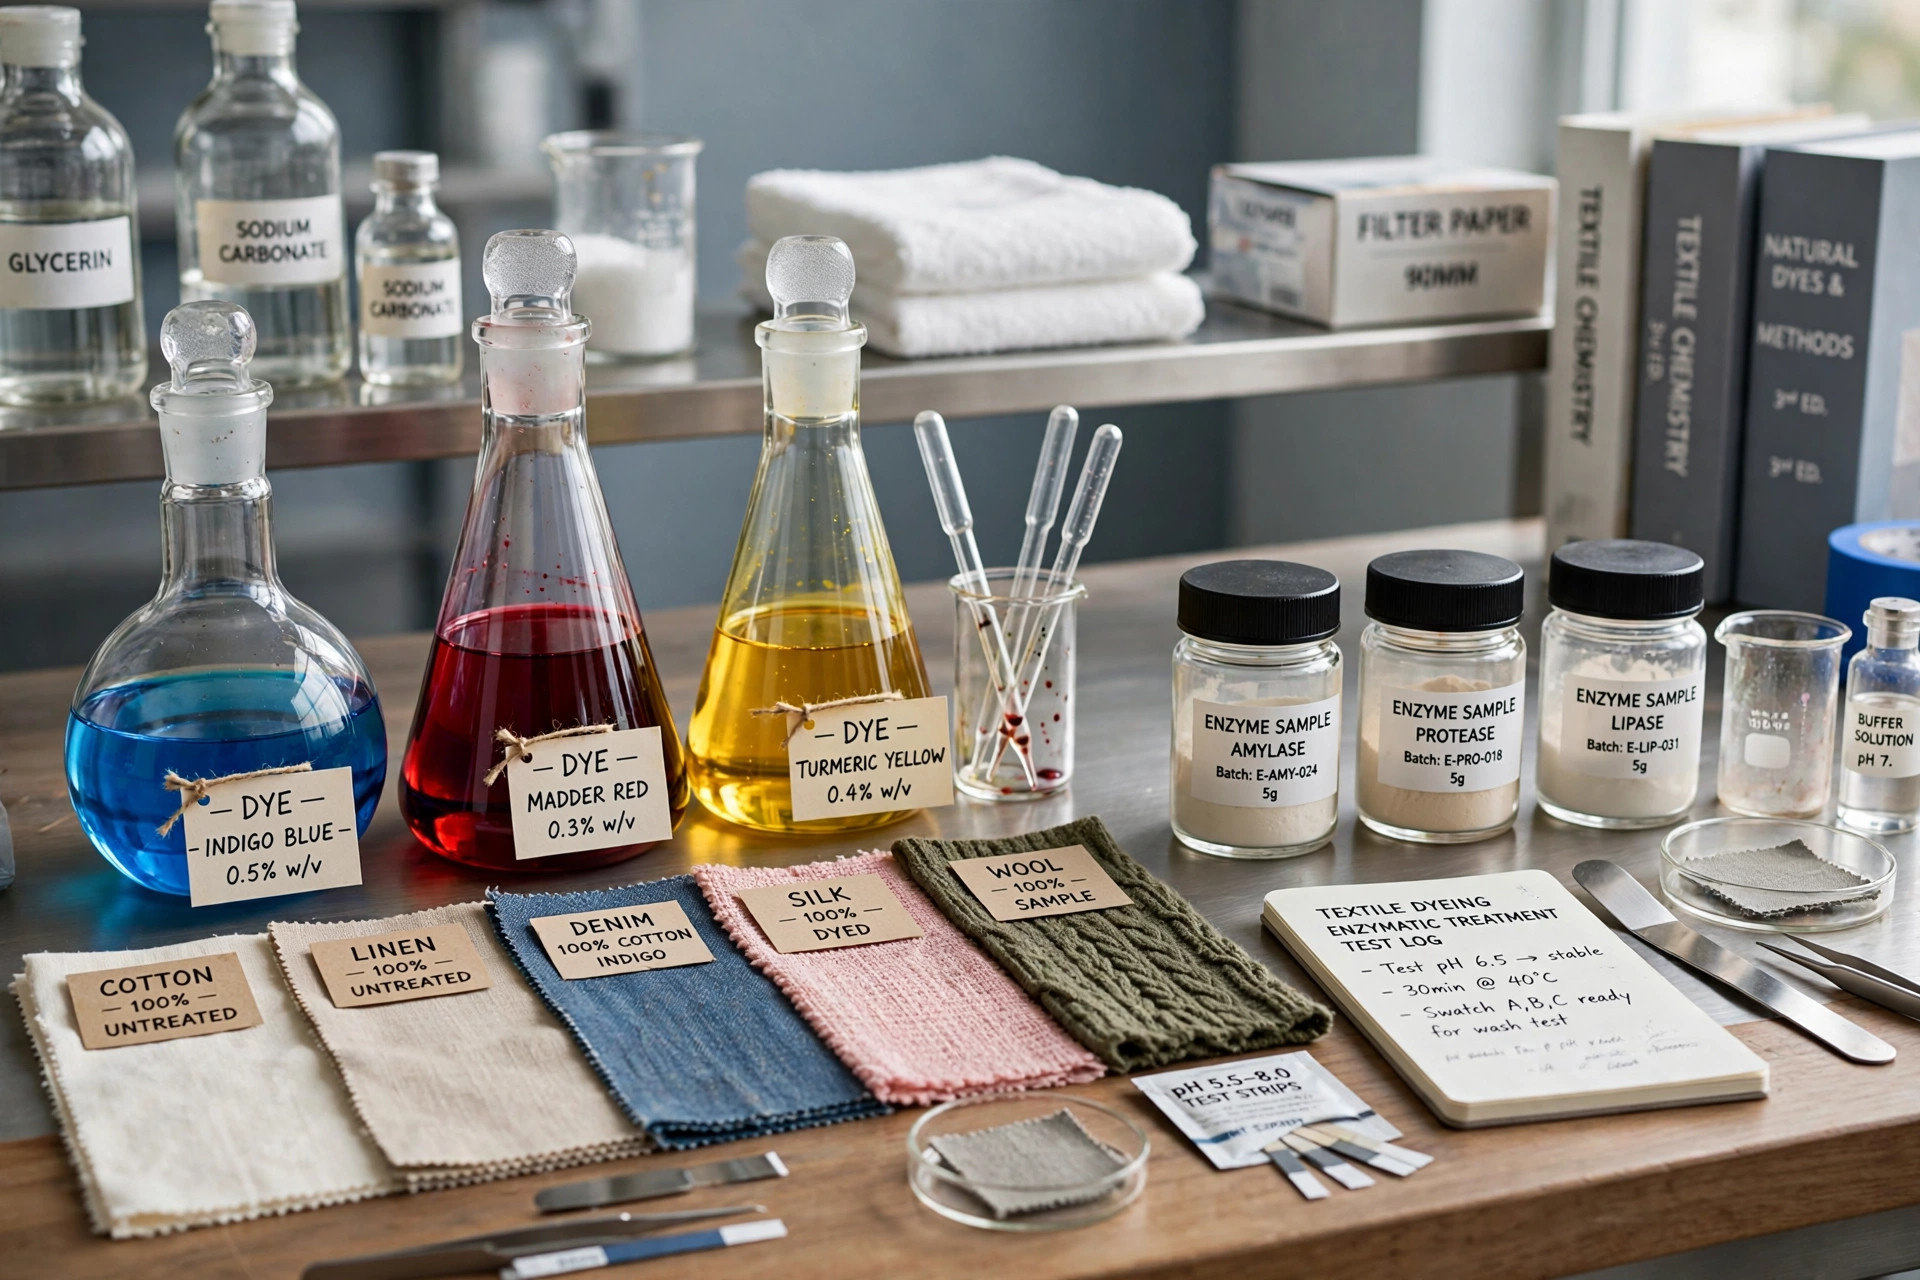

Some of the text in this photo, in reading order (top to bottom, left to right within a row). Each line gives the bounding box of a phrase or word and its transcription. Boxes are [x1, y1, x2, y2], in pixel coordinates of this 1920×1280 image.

[236, 219, 311, 239] SODIUM
[1357, 204, 1531, 242] FILTER PAPER
[9, 249, 111, 273] GLYCERIN
[219, 241, 327, 262] CARBONATE
[1764, 233, 1859, 268] NATURAL
[1404, 260, 1479, 291] 90MM
[1772, 264, 1845, 297] DYES &
[1570, 186, 1602, 446] TEXTILE CHEMISTRY
[1665, 214, 1702, 477] TEXTILE CHEMISTRY
[1756, 321, 1855, 360] METHODS
[1393, 697, 1516, 720] ENZYME SAMPLE
[1576, 685, 1697, 708] ENZYME SAMPLE
[843, 717, 889, 744] DYE
[1205, 711, 1331, 735] ENZYME SAMPLE
[1611, 715, 1664, 731] LIPASE
[1858, 712, 1903, 729] BUFFER
[1416, 725, 1495, 743] PROTEASE
[1587, 738, 1679, 753] Batch: E-LIP-031
[1854, 729, 1914, 747] SOLUTION
[1230, 741, 1306, 758] AMYLASE
[1404, 749, 1503, 766] Batch: E-PRO-018
[1857, 753, 1875, 767] pH
[561, 749, 609, 777] DYE
[795, 746, 945, 779] TURMERIC YELLOW
[1216, 764, 1318, 781] Batch: E-AMY-024
[1632, 759, 1647, 774] 5g
[827, 777, 912, 804] 0.4% w/v
[1450, 772, 1465, 787] 5g
[241, 790, 292, 820] DYE
[527, 780, 649, 813] MADDER RED
[1262, 787, 1278, 802] 5g
[548, 810, 636, 839] 0.3% w/v
[205, 822, 333, 857] INDIGO BLUE
[226, 854, 322, 885] 0.5% w/v
[985, 858, 1064, 879] WOOL
[788, 886, 852, 907] SILK
[1013, 877, 1065, 893] 100%
[1015, 890, 1096, 911] SAMPLE
[1315, 896, 1492, 920] TEXTILE DYEING
[569, 912, 655, 936] DENIM
[803, 906, 857, 923] 100%
[1326, 908, 1560, 937] ENZYMATIC TREATMENT
[557, 928, 693, 955] 100% COTTON
[812, 924, 871, 941] DYED
[1340, 934, 1443, 953] TEST LOG
[350, 936, 436, 962] LINEN
[596, 949, 667, 968] INDIGO
[1379, 945, 1604, 976] Test pH 6.5 stable
[372, 959, 428, 976] 100%
[100, 965, 213, 996] COTTON
[350, 971, 471, 997] UNTREATED
[1402, 971, 1558, 997] 30min @ 40°C
[130, 992, 190, 1013] 100%
[1423, 990, 1632, 1019] Swatch A,B,C ready
[104, 1007, 238, 1037] UNTREATED
[1432, 1014, 1569, 1039] for wash test
[1171, 1080, 1205, 1099] pH
[1181, 1081, 1303, 1108] TEST STRIPS
